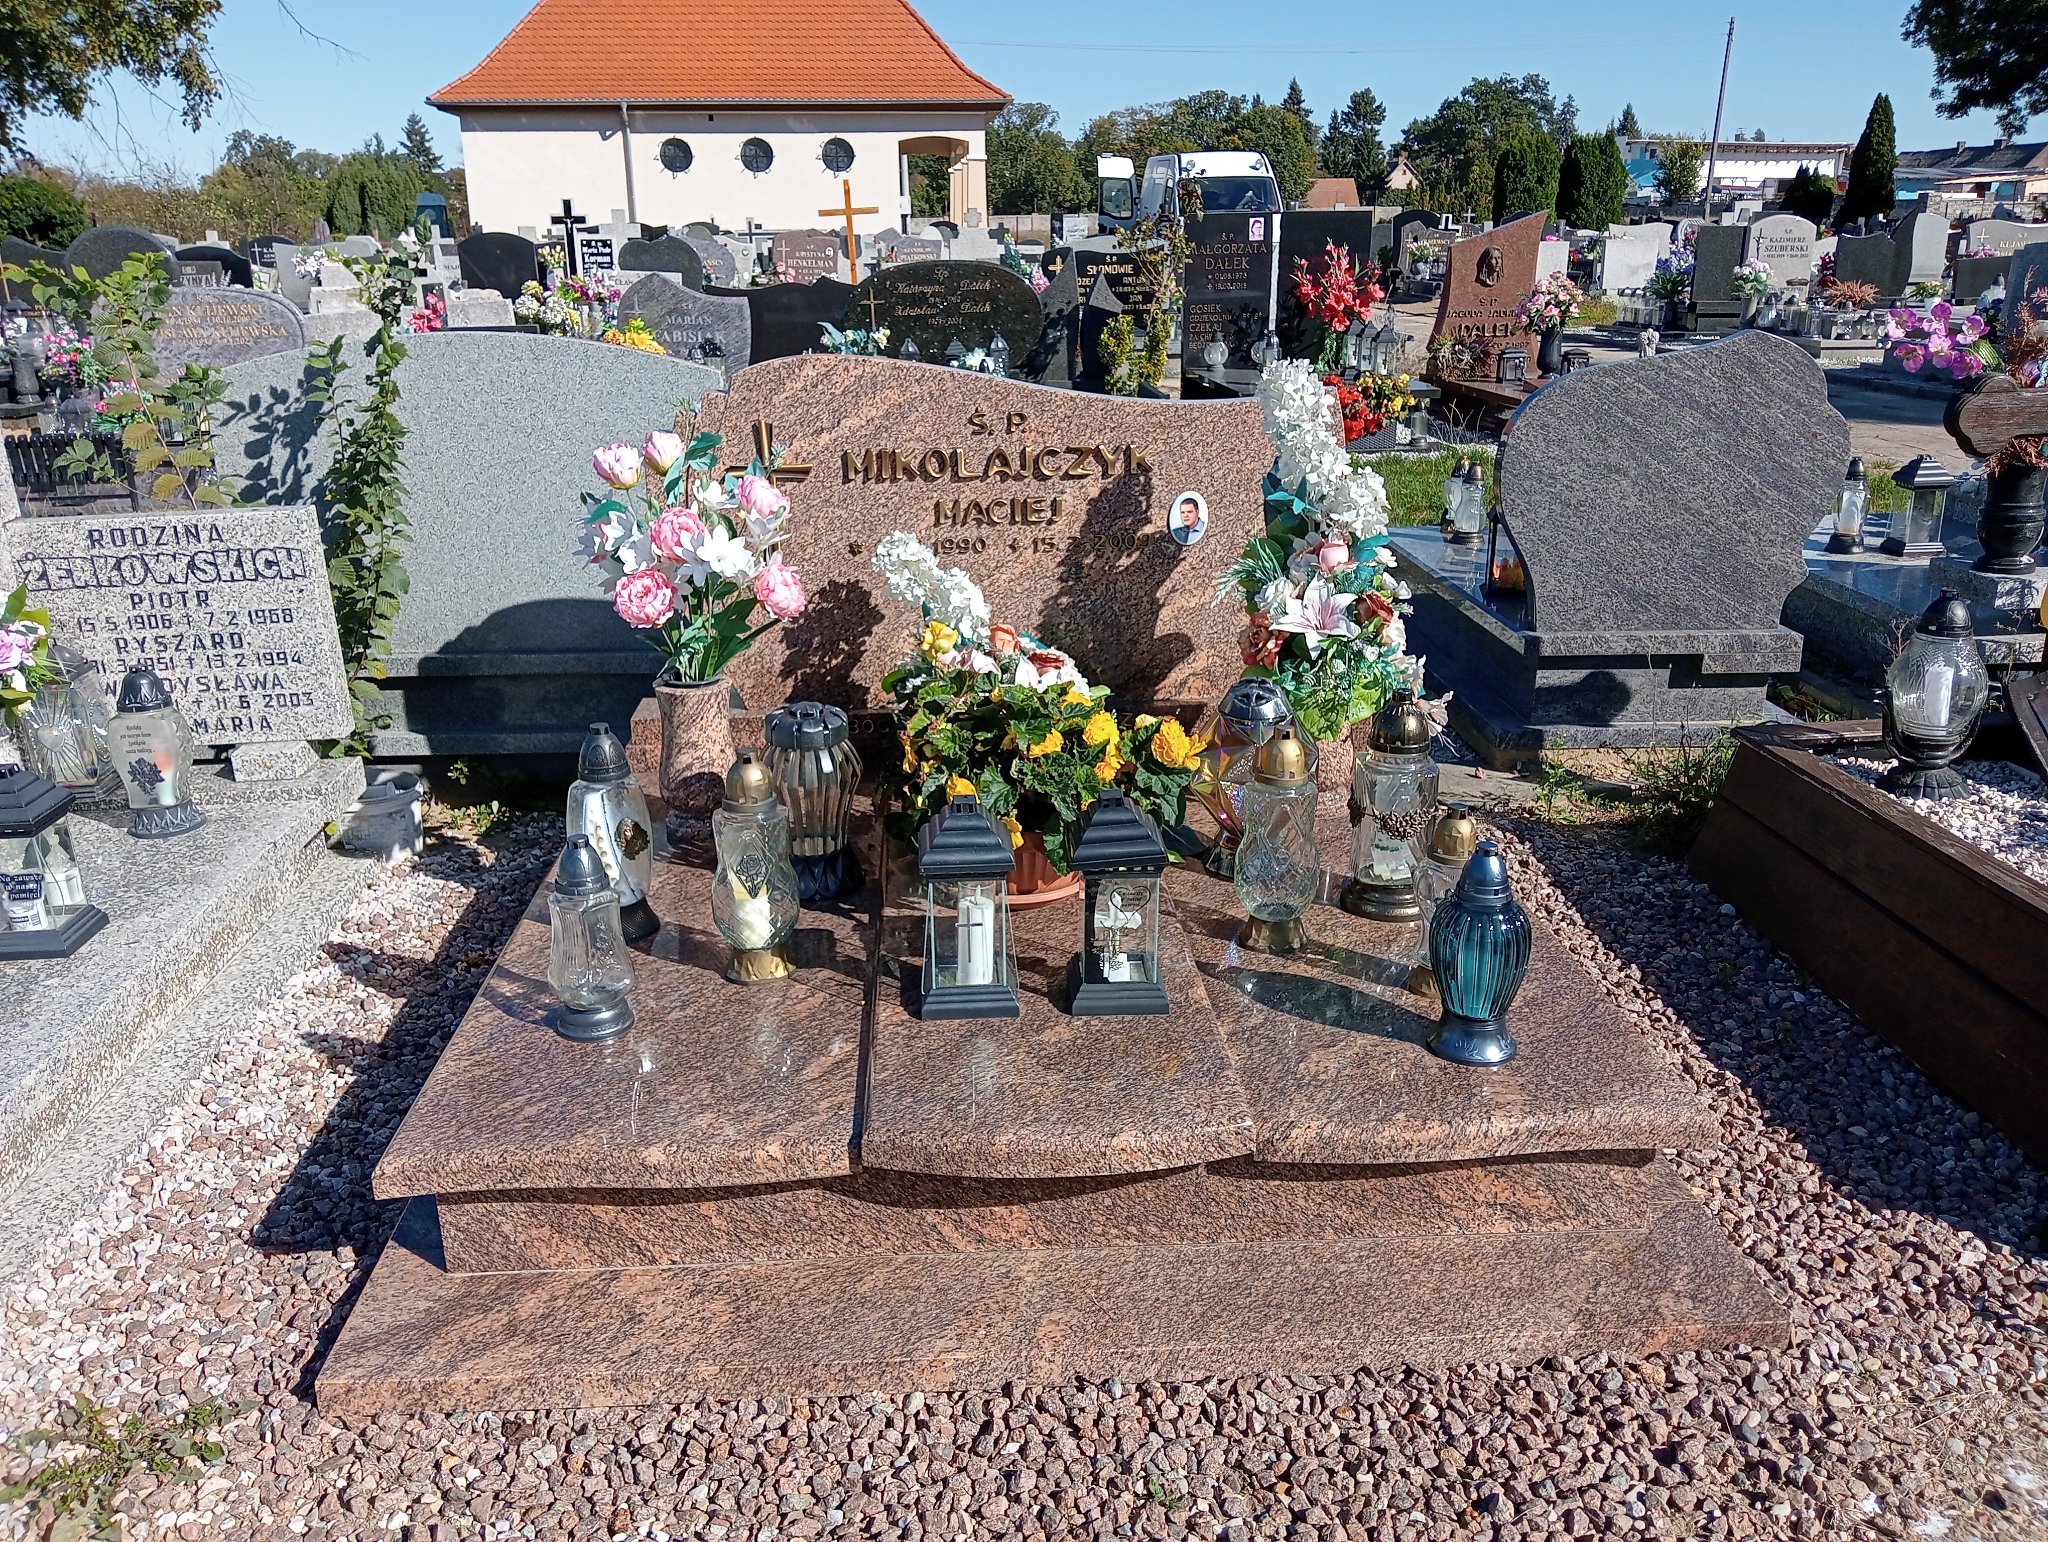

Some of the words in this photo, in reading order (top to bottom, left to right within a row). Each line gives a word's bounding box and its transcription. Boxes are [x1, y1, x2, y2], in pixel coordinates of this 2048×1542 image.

[1764, 244, 1809, 252] SZUBERSKI
[936, 497, 1065, 526] MACIEJ
[87, 524, 226, 549] RODZINA
[935, 536, 988, 554] 1990
[1094, 534, 1151, 550] 2009
[130, 590, 210, 610] PIOTR
[128, 613, 173, 631] 1906
[203, 611, 215, 627] 7
[227, 610, 240, 626] 2
[249, 607, 294, 625] 1968
[115, 632, 245, 654] RYSZARD
[206, 653, 225, 670] 13
[235, 652, 248, 668] 2
[256, 650, 304, 667] 1994
[263, 691, 315, 709] 2003
[193, 714, 274, 733] MARIA
[10, 892, 40, 901] pamięci
